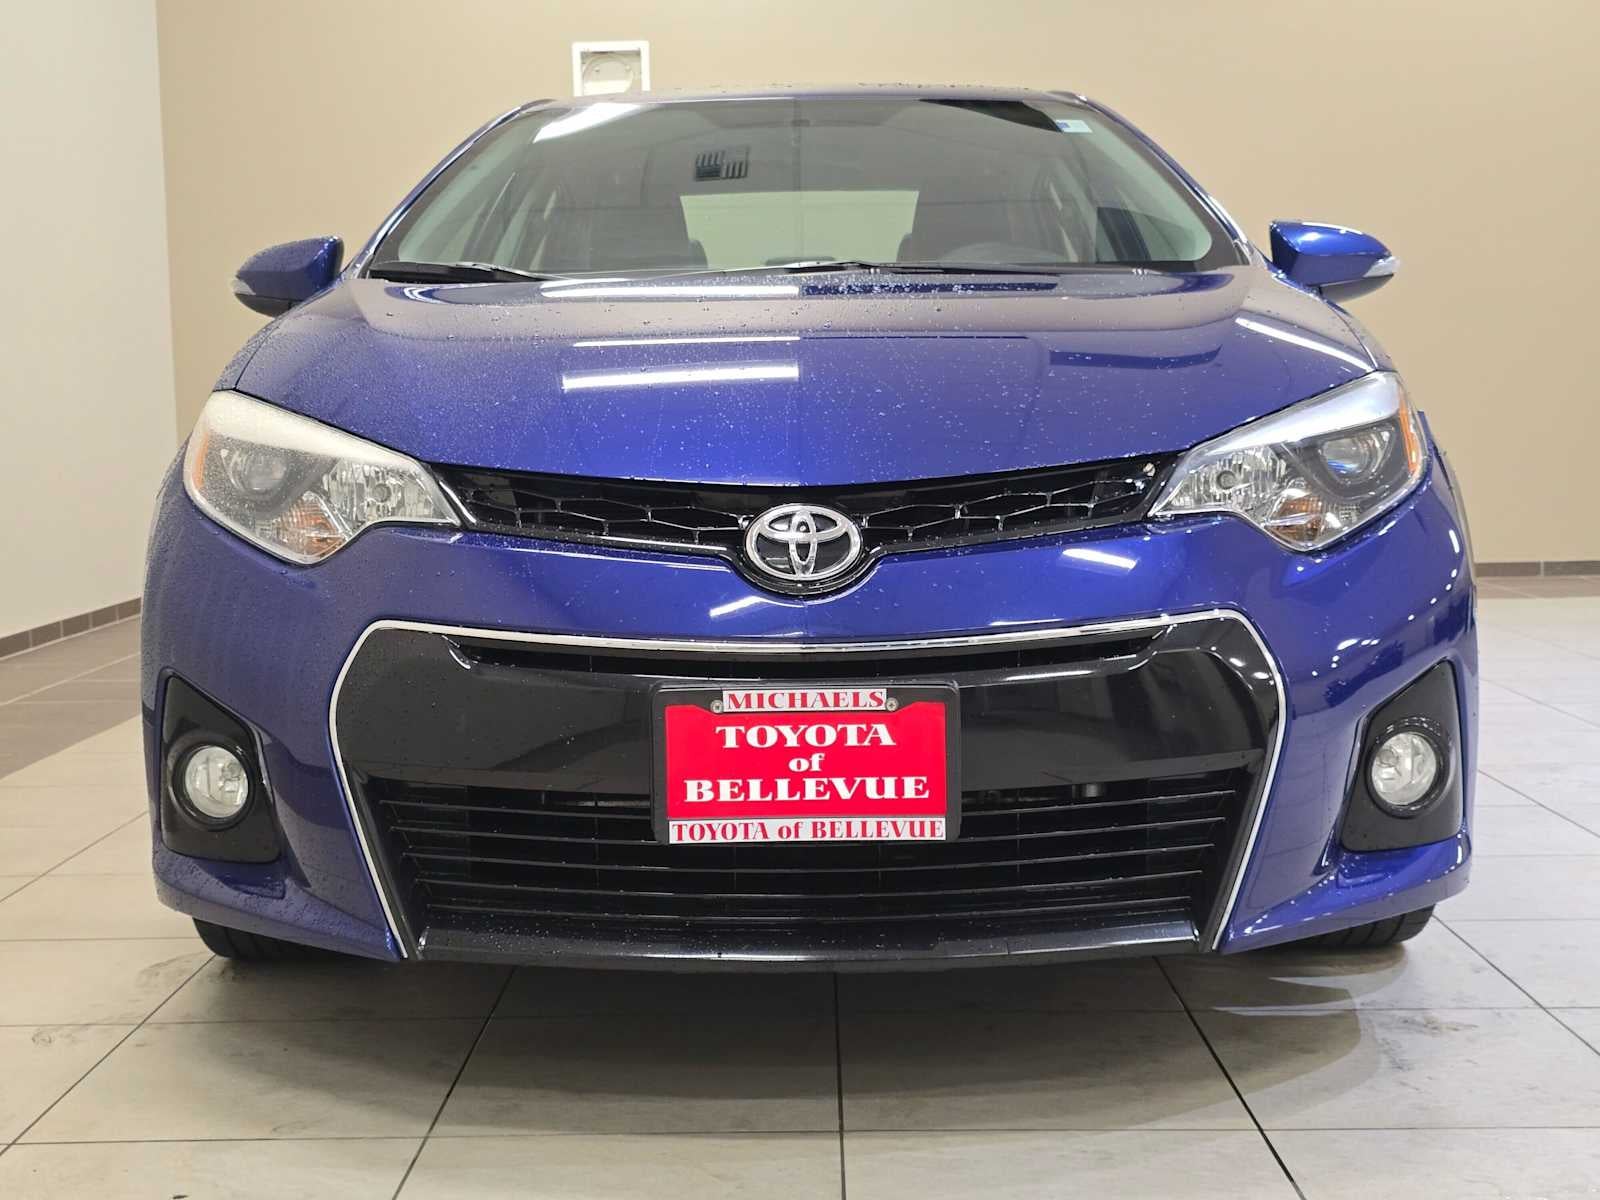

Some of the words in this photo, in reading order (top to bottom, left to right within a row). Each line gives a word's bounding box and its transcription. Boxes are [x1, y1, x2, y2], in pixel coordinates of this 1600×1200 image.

[727, 689, 884, 710] MICHAELS
[715, 723, 896, 749] TOYOTA
[788, 753, 825, 772] of
[684, 776, 930, 802] BELLEVUE
[672, 821, 770, 842] TOYOTA
[777, 821, 803, 840] of
[811, 819, 945, 839] BELLEVUE
